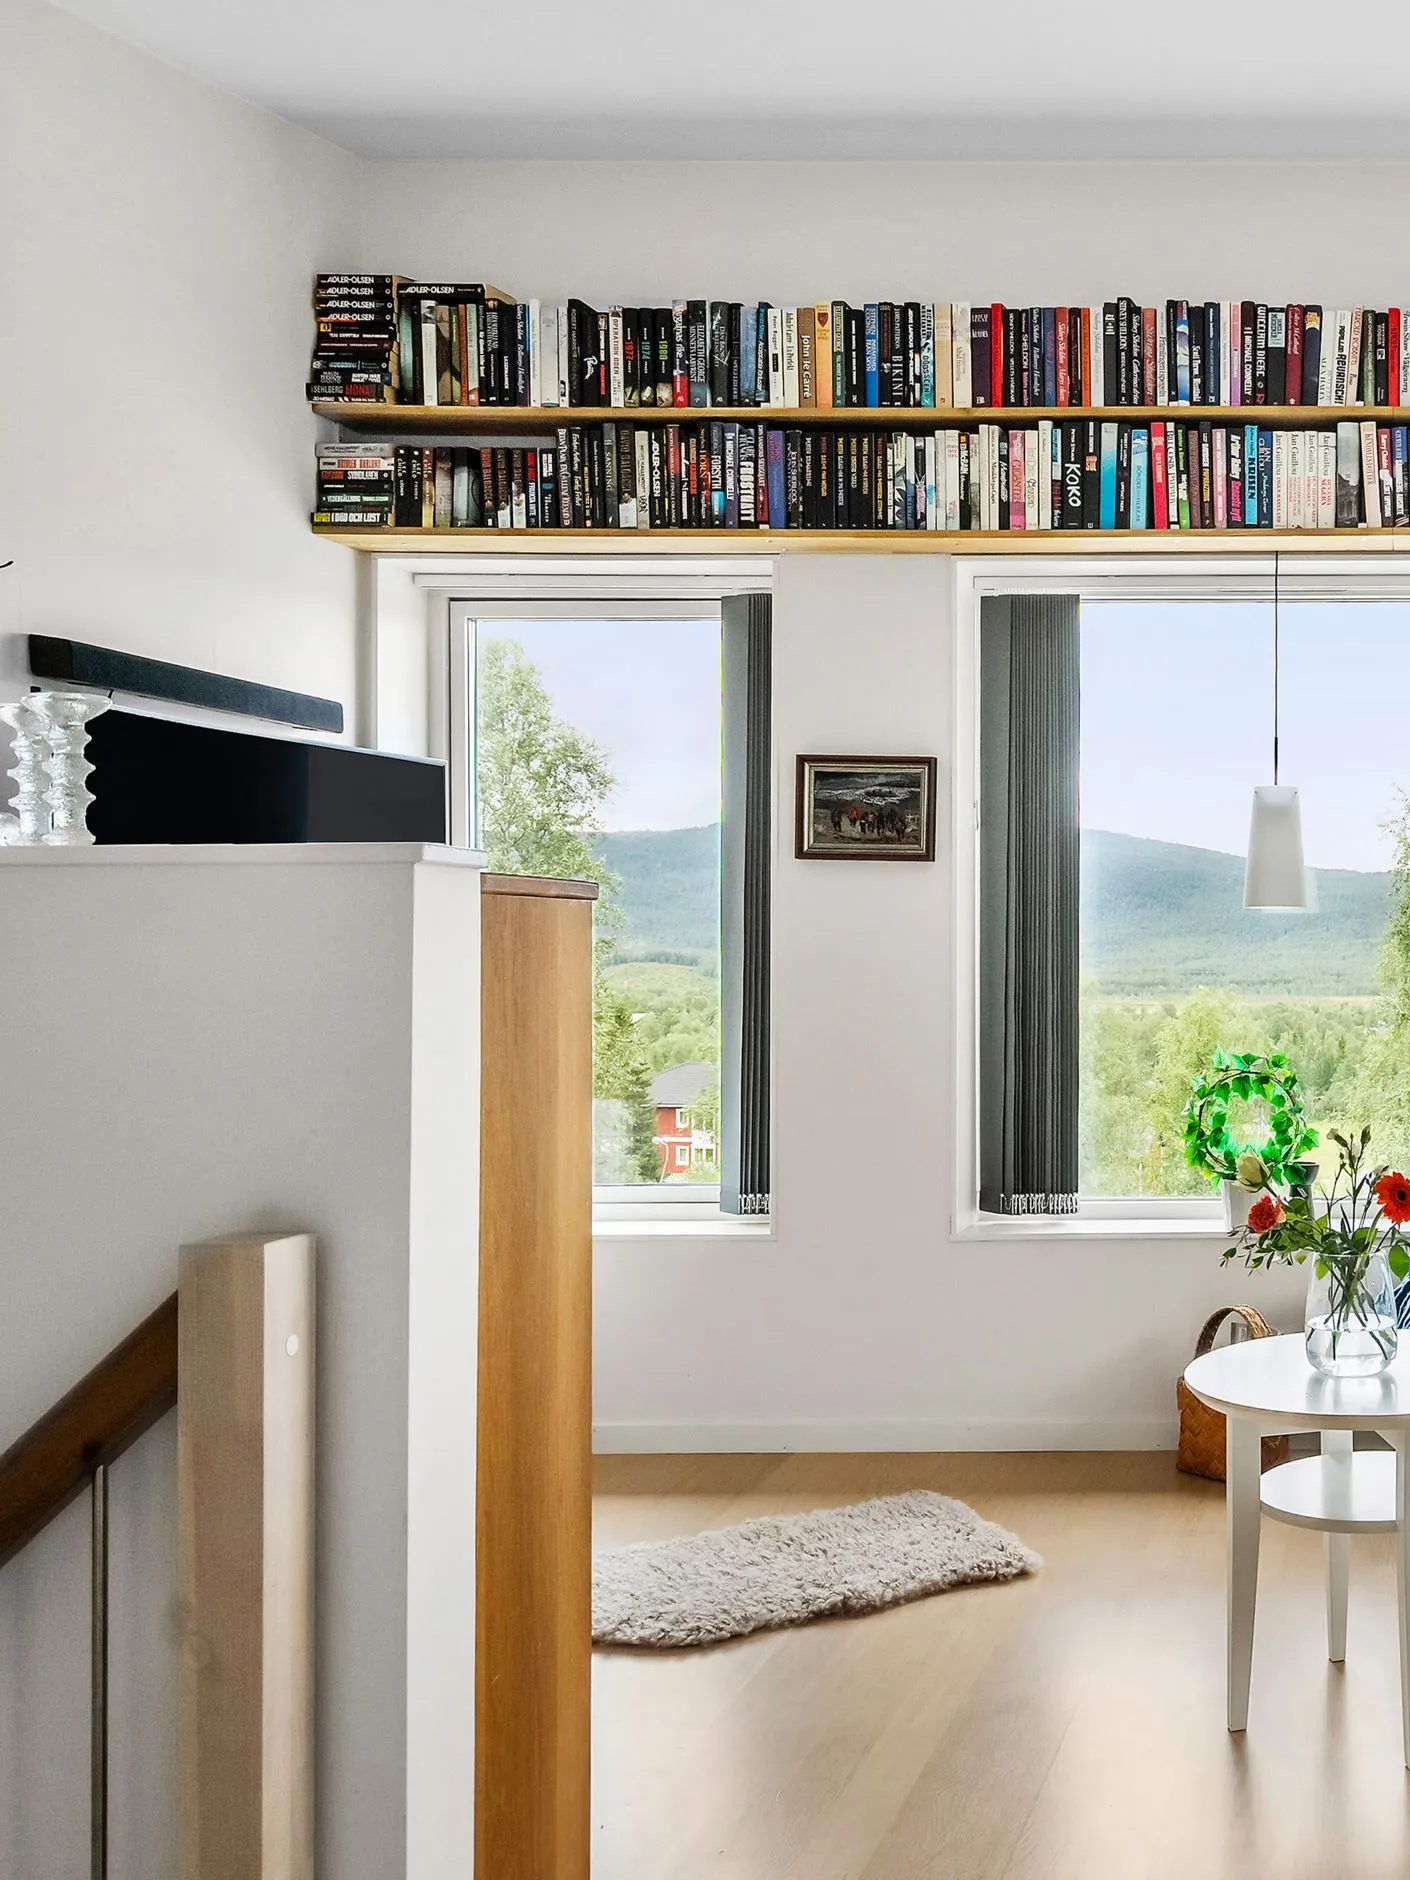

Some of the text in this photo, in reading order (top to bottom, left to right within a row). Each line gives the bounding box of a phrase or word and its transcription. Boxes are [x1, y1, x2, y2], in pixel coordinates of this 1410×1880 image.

[326, 287, 373, 295] ADLER-OLSEN
[327, 276, 374, 284] ADLER-OLSEN
[406, 286, 454, 294] ADLER-OLSEN
[326, 301, 374, 309] ADLER-OLSEN
[328, 314, 374, 322] ADLER-OLSEN
[626, 340, 634, 360] 1977
[641, 341, 650, 360] 1974
[659, 340, 668, 360] 1980
[697, 325, 705, 357] ELIZABETH
[1256, 307, 1266, 377] WILLIAM DIEHL
[801, 335, 812, 398] John le Carré
[892, 356, 903, 396] BIKINI
[1335, 354, 1346, 404] REVANSCH!
[1291, 433, 1299, 446] Jan
[652, 440, 660, 497] ADLER-OLSEN
[711, 455, 721, 489] FORSYTH
[960, 450, 968, 475] McBAIN
[726, 469, 734, 501] CONNELLY
[1065, 463, 1081, 507] KOKO
[349, 513, 363, 522] OCH
[364, 513, 381, 522] LUST
